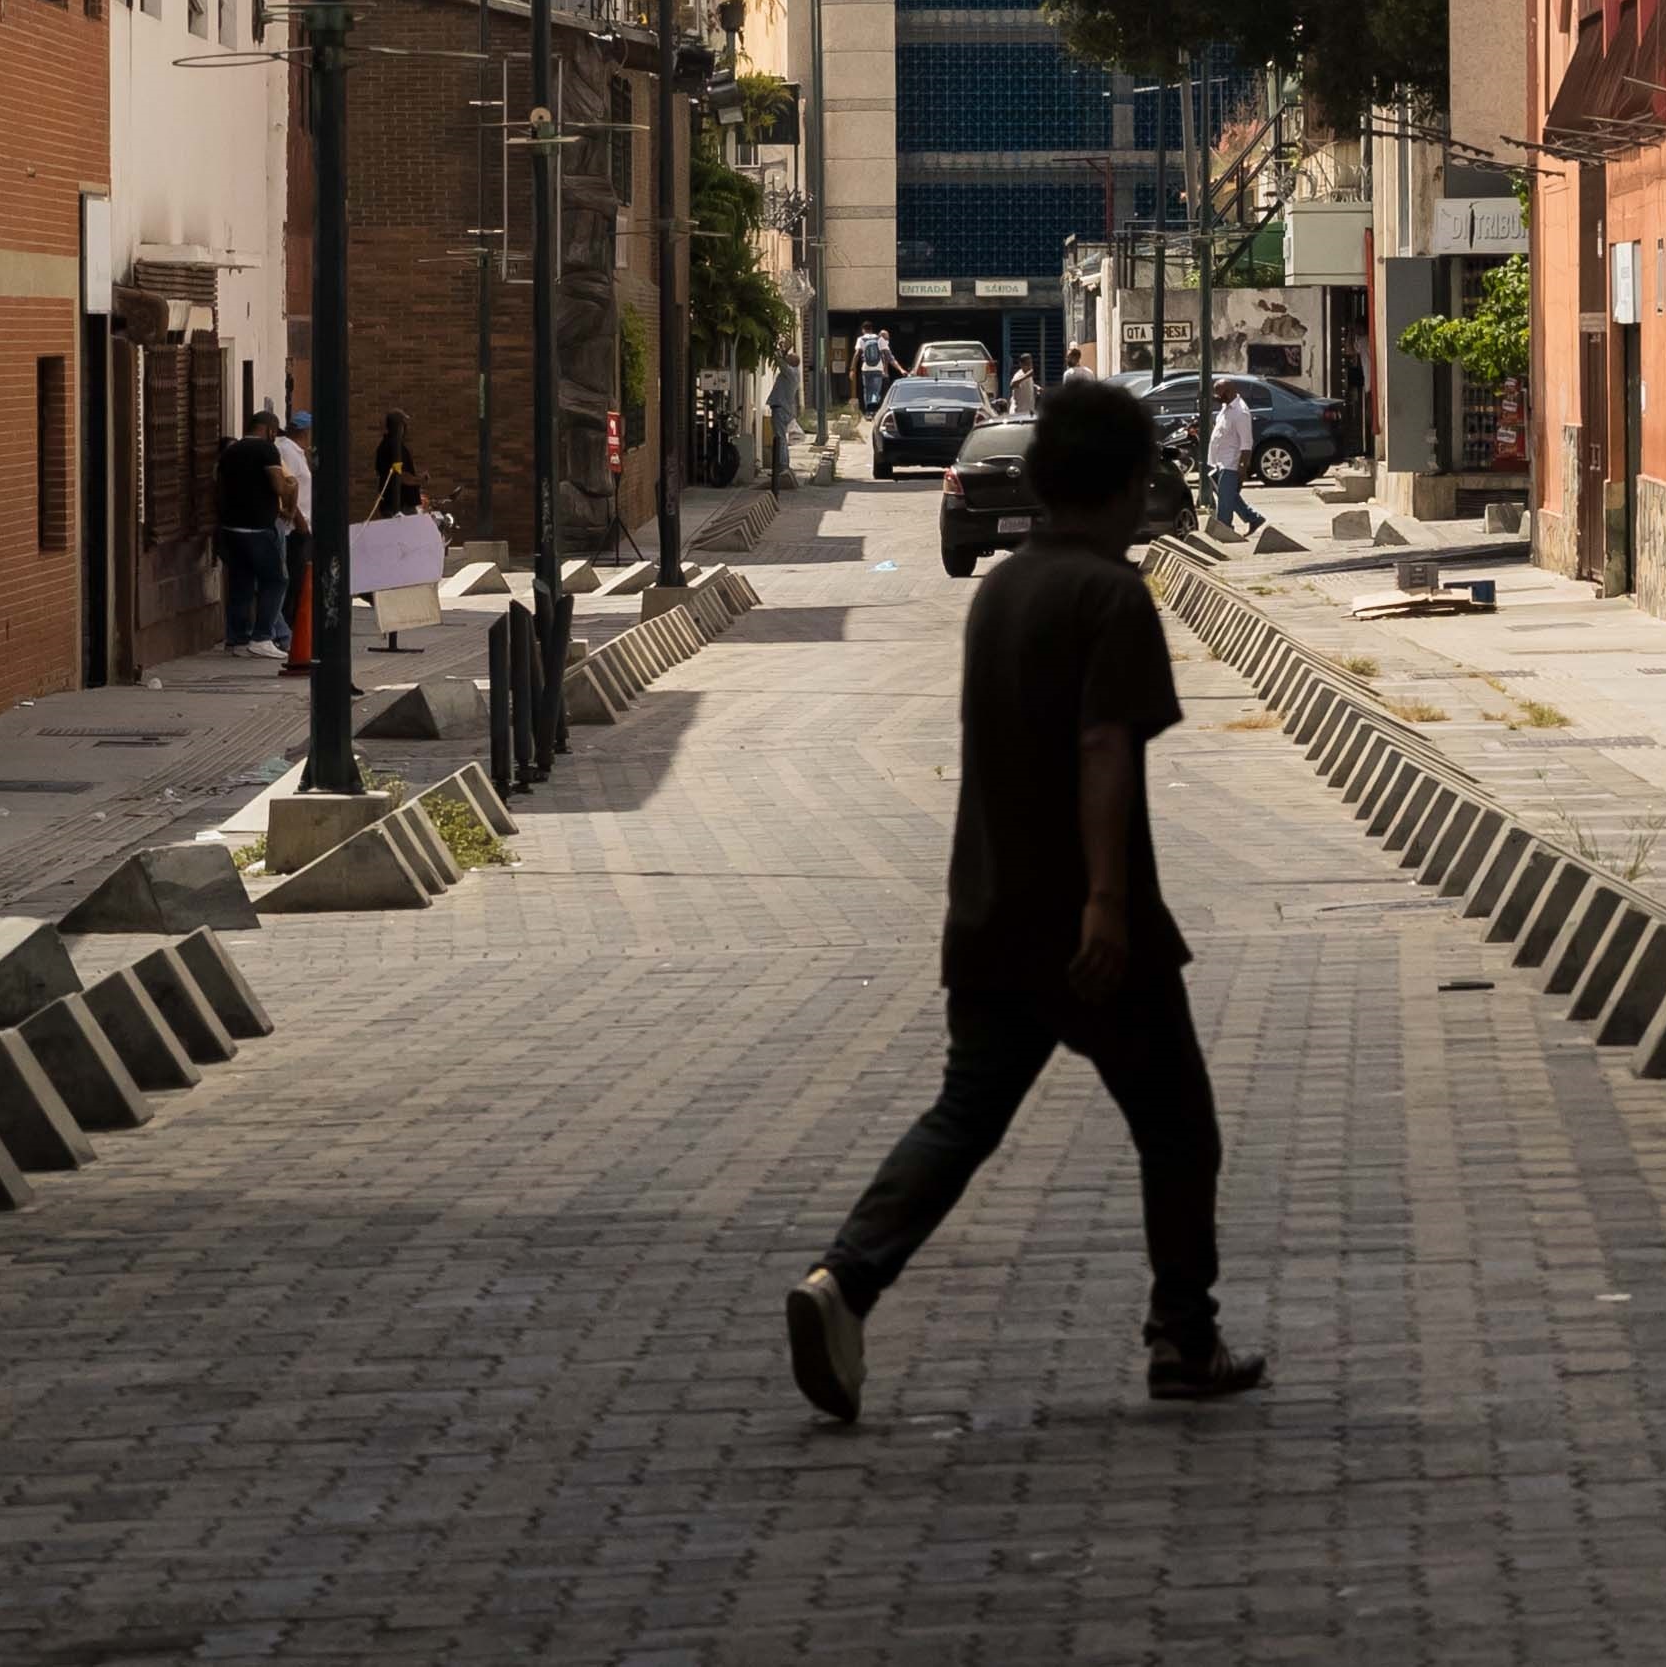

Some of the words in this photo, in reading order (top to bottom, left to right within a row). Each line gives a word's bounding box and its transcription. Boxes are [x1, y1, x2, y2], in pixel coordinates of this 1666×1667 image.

[1452, 214, 1526, 240] DITRIBU
[901, 285, 948, 294] ENTRADA
[1126, 326, 1146, 340] QTA
[1150, 325, 1188, 339] TRESA
